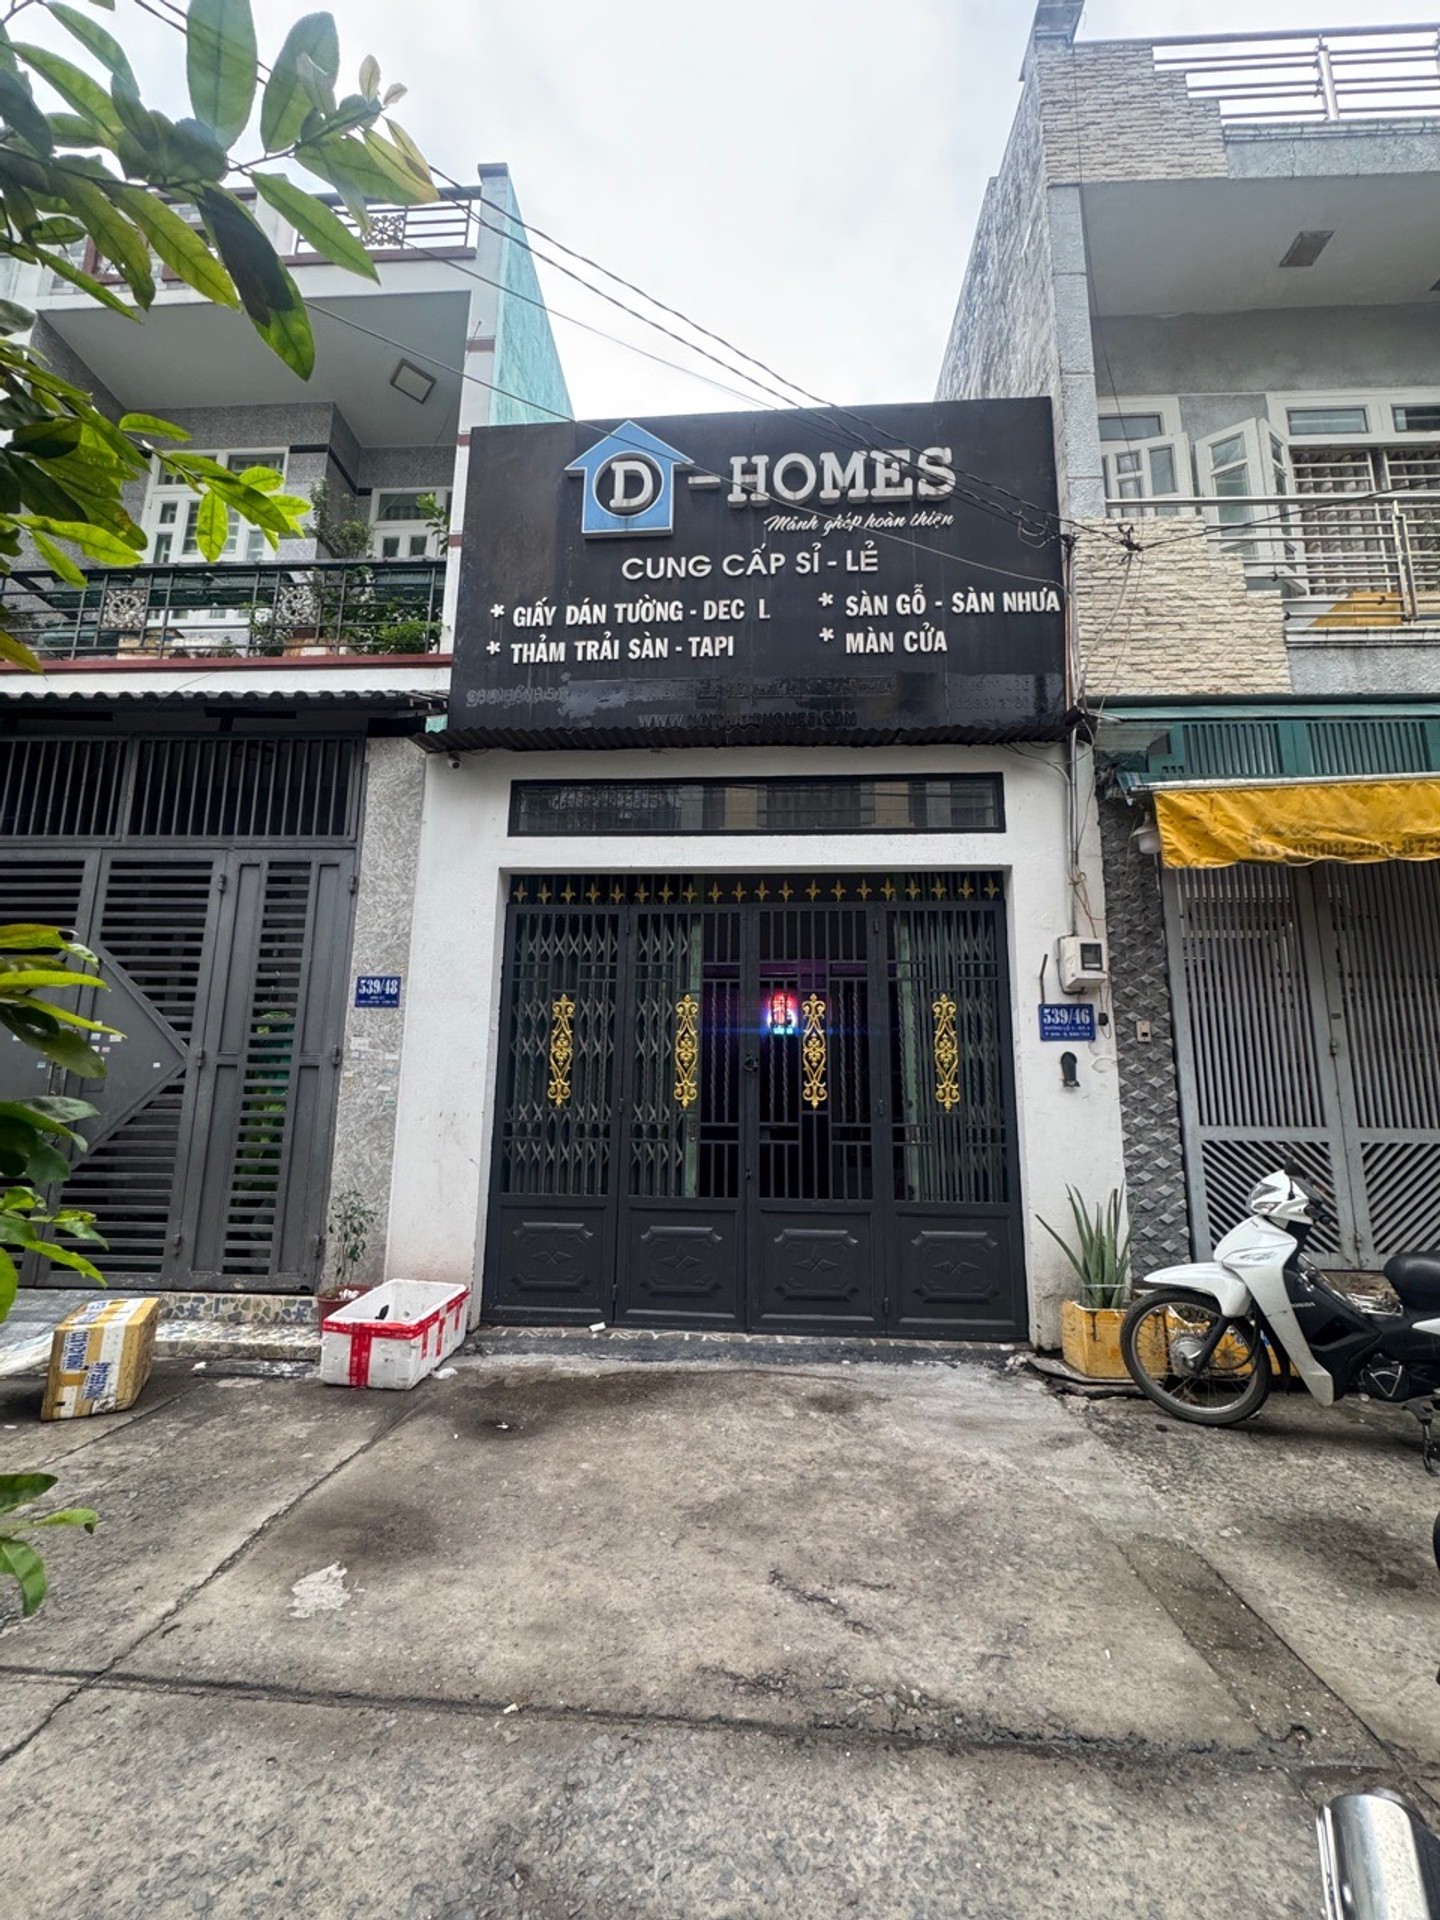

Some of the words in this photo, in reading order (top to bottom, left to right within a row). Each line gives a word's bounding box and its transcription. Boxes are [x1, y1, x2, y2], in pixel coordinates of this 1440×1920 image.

[609, 460, 654, 513] D
[727, 446, 957, 505] HOMES
[864, 511, 907, 529] hoàn
[621, 555, 712, 581] CUNG
[721, 542, 786, 577] CẤP
[845, 540, 879, 573] LẺ
[513, 597, 557, 628] GIẤY
[565, 597, 607, 626] DÁN
[614, 594, 684, 624] TƯỜNG
[703, 598, 746, 622] DEC
[758, 598, 772, 620] L
[845, 587, 889, 618] SÀN
[896, 583, 927, 616] GỖ
[951, 586, 995, 614] SÀN
[511, 633, 566, 664] THẢM
[574, 631, 620, 661] TRẢI
[628, 631, 668, 660] SÀN
[688, 635, 734, 658] TAPI
[845, 626, 894, 655] MÀN
[903, 622, 948, 653] CỬA
[1043, 1008, 1091, 1025] 539/46
